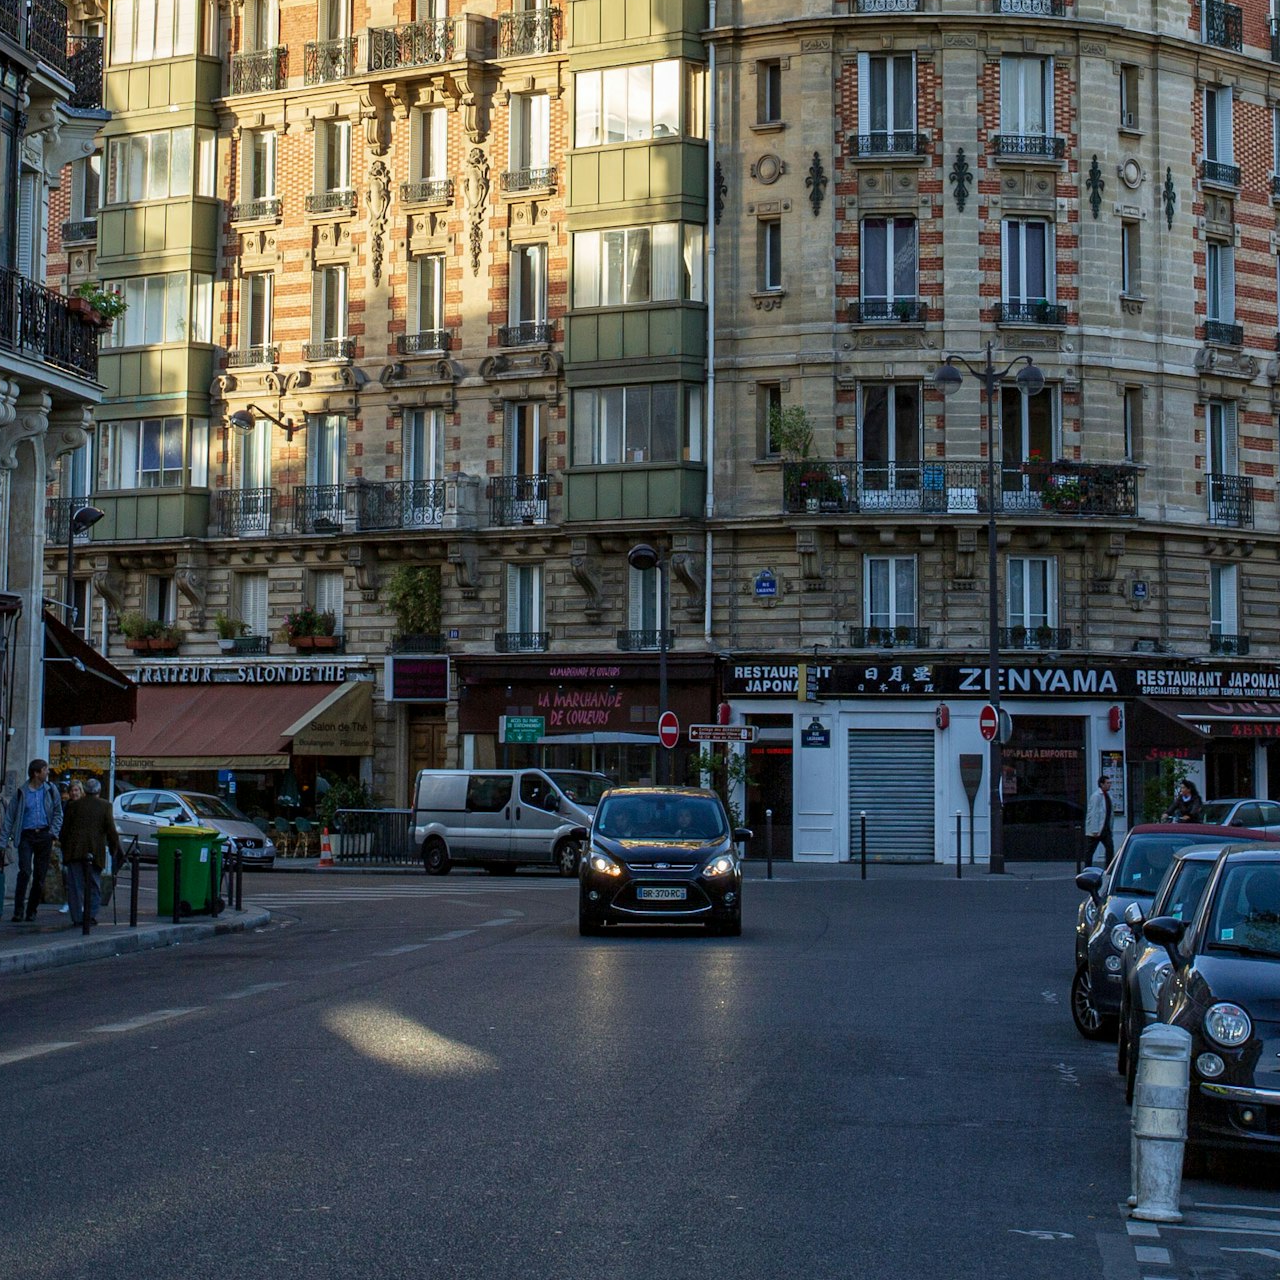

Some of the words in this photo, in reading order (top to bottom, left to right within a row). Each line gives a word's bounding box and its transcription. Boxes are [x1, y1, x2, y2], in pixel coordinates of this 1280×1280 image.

[135, 667, 212, 683] TRAITEUR
[238, 666, 287, 682] SALON
[291, 666, 312, 682] DE
[958, 668, 1118, 693] ZENYAMA
[1136, 669, 1222, 687] RESTAURANT
[537, 692, 550, 708] LA
[553, 691, 624, 708] MARCHANDE
[1142, 686, 1180, 695] SPECIALITES
[1181, 686, 1198, 696] SUSHI
[549, 709, 564, 726] DE
[566, 709, 612, 726] COULEURS
[311, 721, 336, 733] Salon
[337, 721, 351, 732] de
[351, 721, 368, 732] Thé
[1040, 749, 1078, 758] EMPORTER
